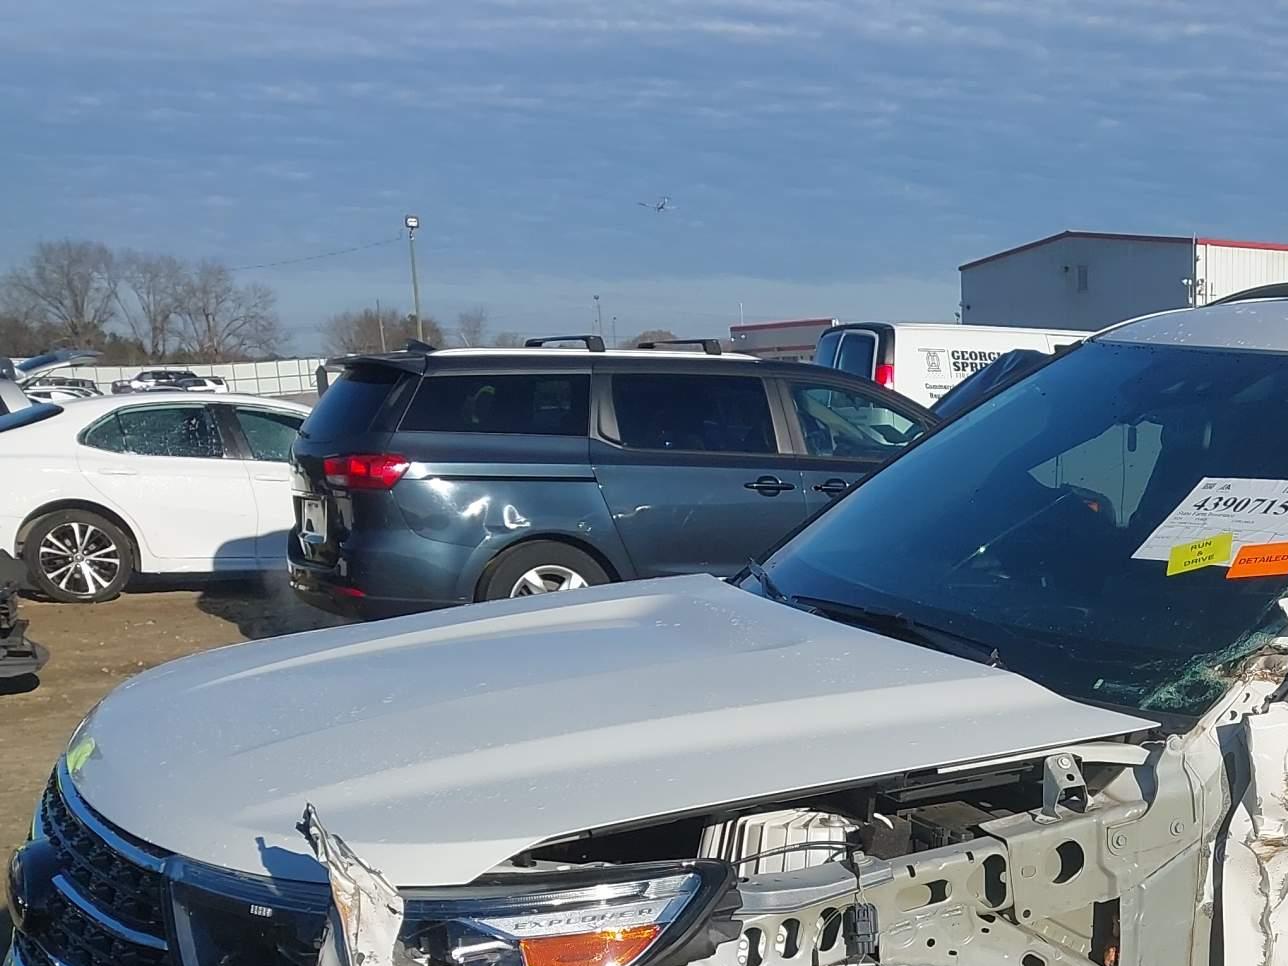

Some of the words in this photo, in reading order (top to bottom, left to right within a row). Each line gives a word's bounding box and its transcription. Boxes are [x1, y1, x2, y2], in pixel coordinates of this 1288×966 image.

[1190, 540, 1212, 552] RUN
[1183, 554, 1215, 567] DRIVE
[514, 908, 653, 931] EXPLORER
